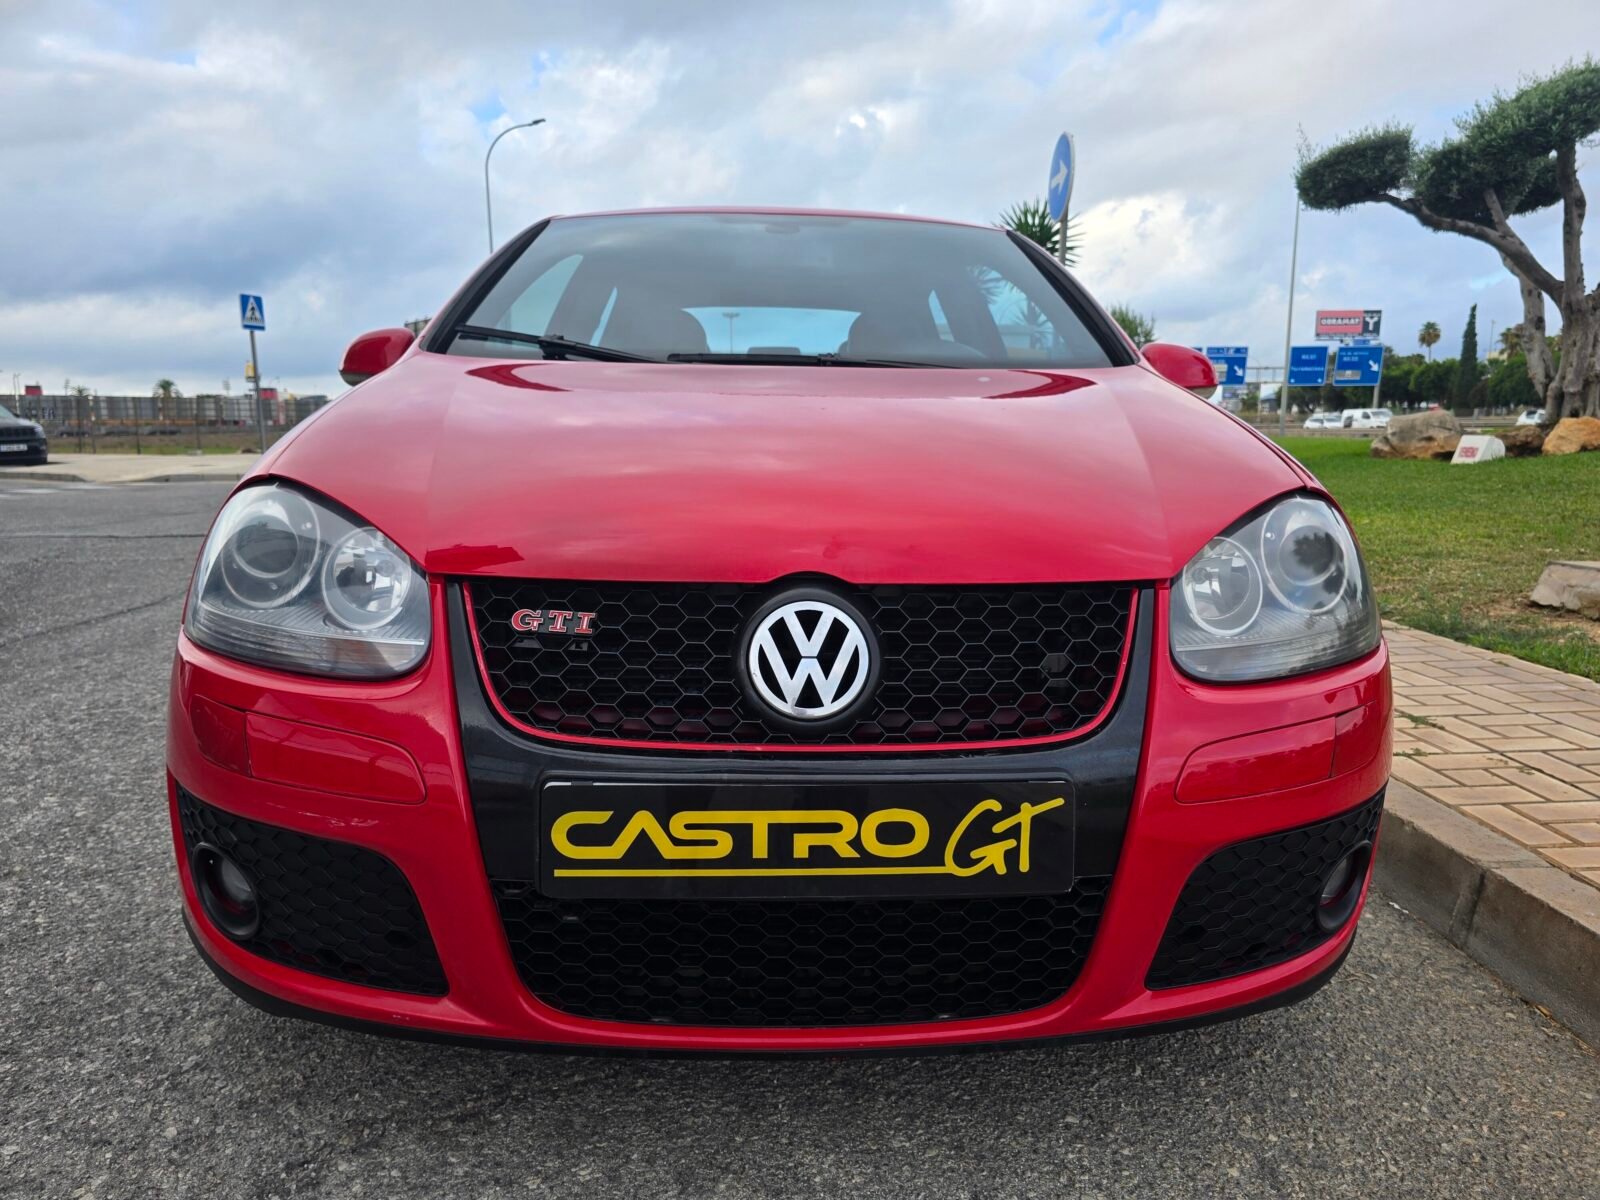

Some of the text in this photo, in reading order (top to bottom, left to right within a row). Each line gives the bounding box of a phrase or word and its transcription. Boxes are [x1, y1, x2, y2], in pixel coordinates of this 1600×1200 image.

[511, 608, 596, 634] GTI
[551, 798, 1065, 877] CASTRO GT
